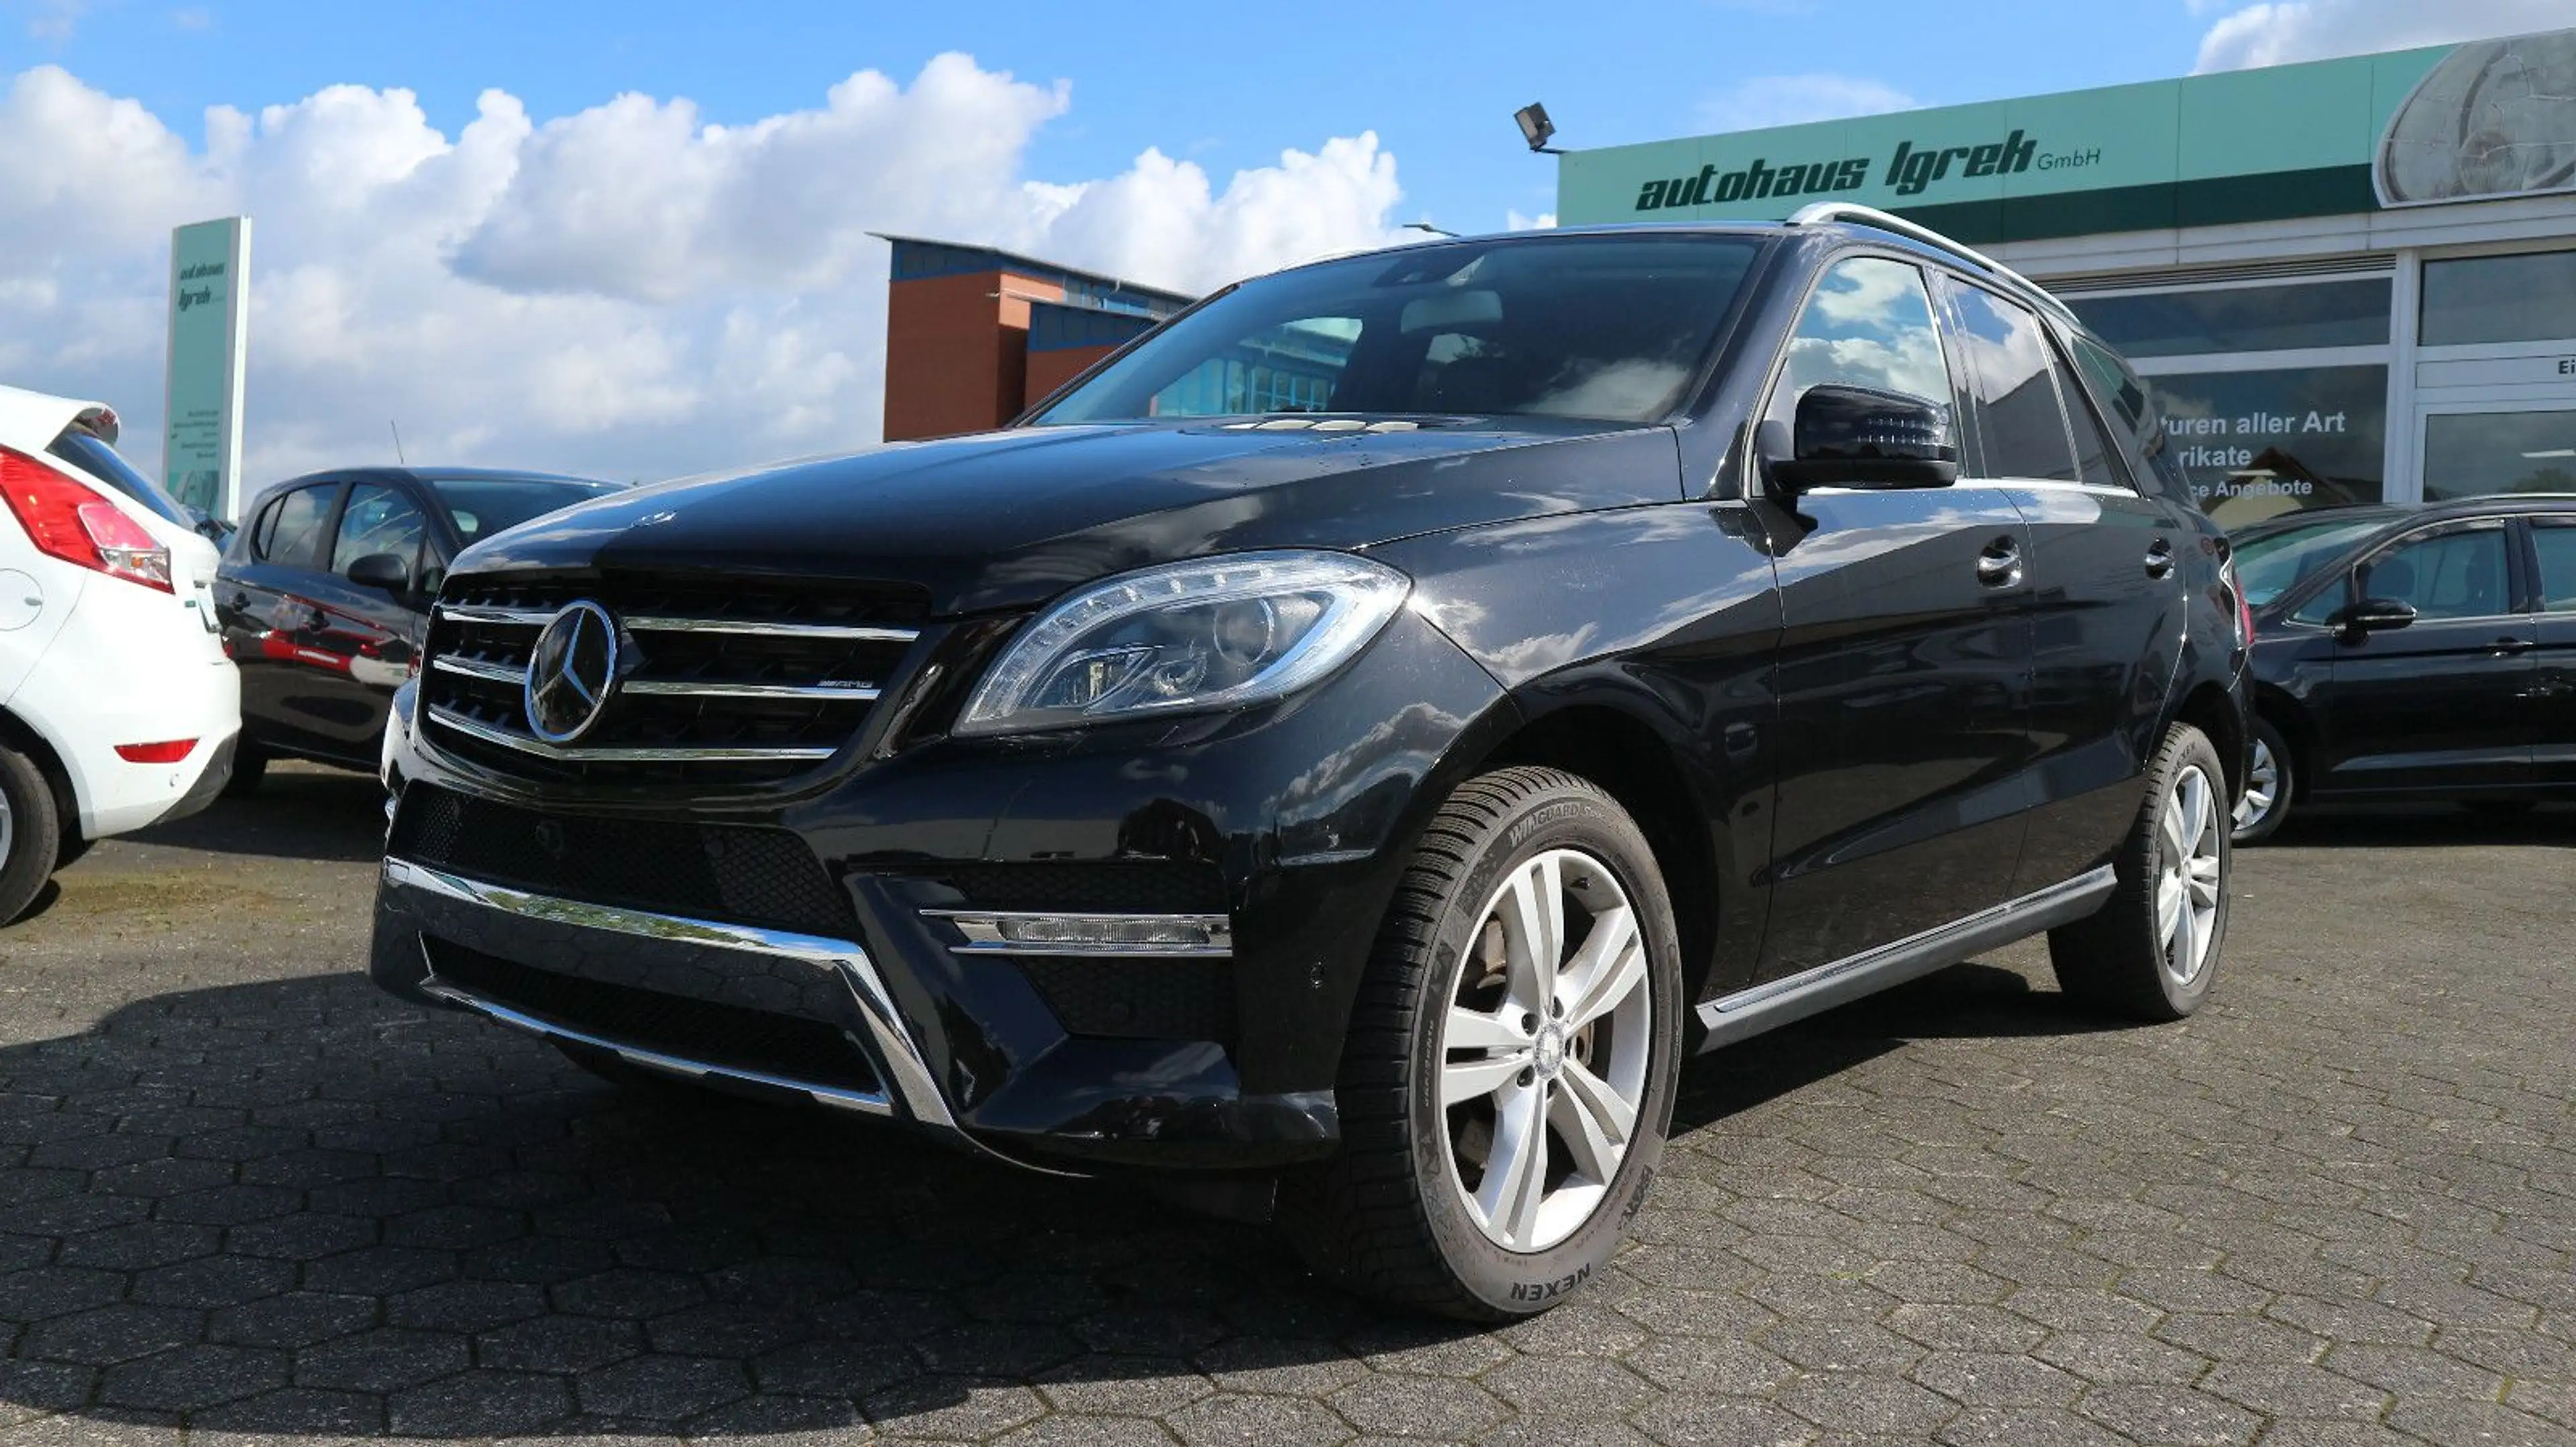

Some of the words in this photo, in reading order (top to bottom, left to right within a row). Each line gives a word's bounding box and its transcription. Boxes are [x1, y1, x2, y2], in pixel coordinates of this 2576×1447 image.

[1635, 158, 1870, 211] autohaus
[1885, 129, 2037, 196] Igrek
[2037, 149, 2101, 170] GmbH
[2235, 412, 2296, 435] aller
[2302, 411, 2346, 433] Art
[2215, 480, 2313, 500] Angebote
[1510, 1262, 1591, 1301] NEXEN
